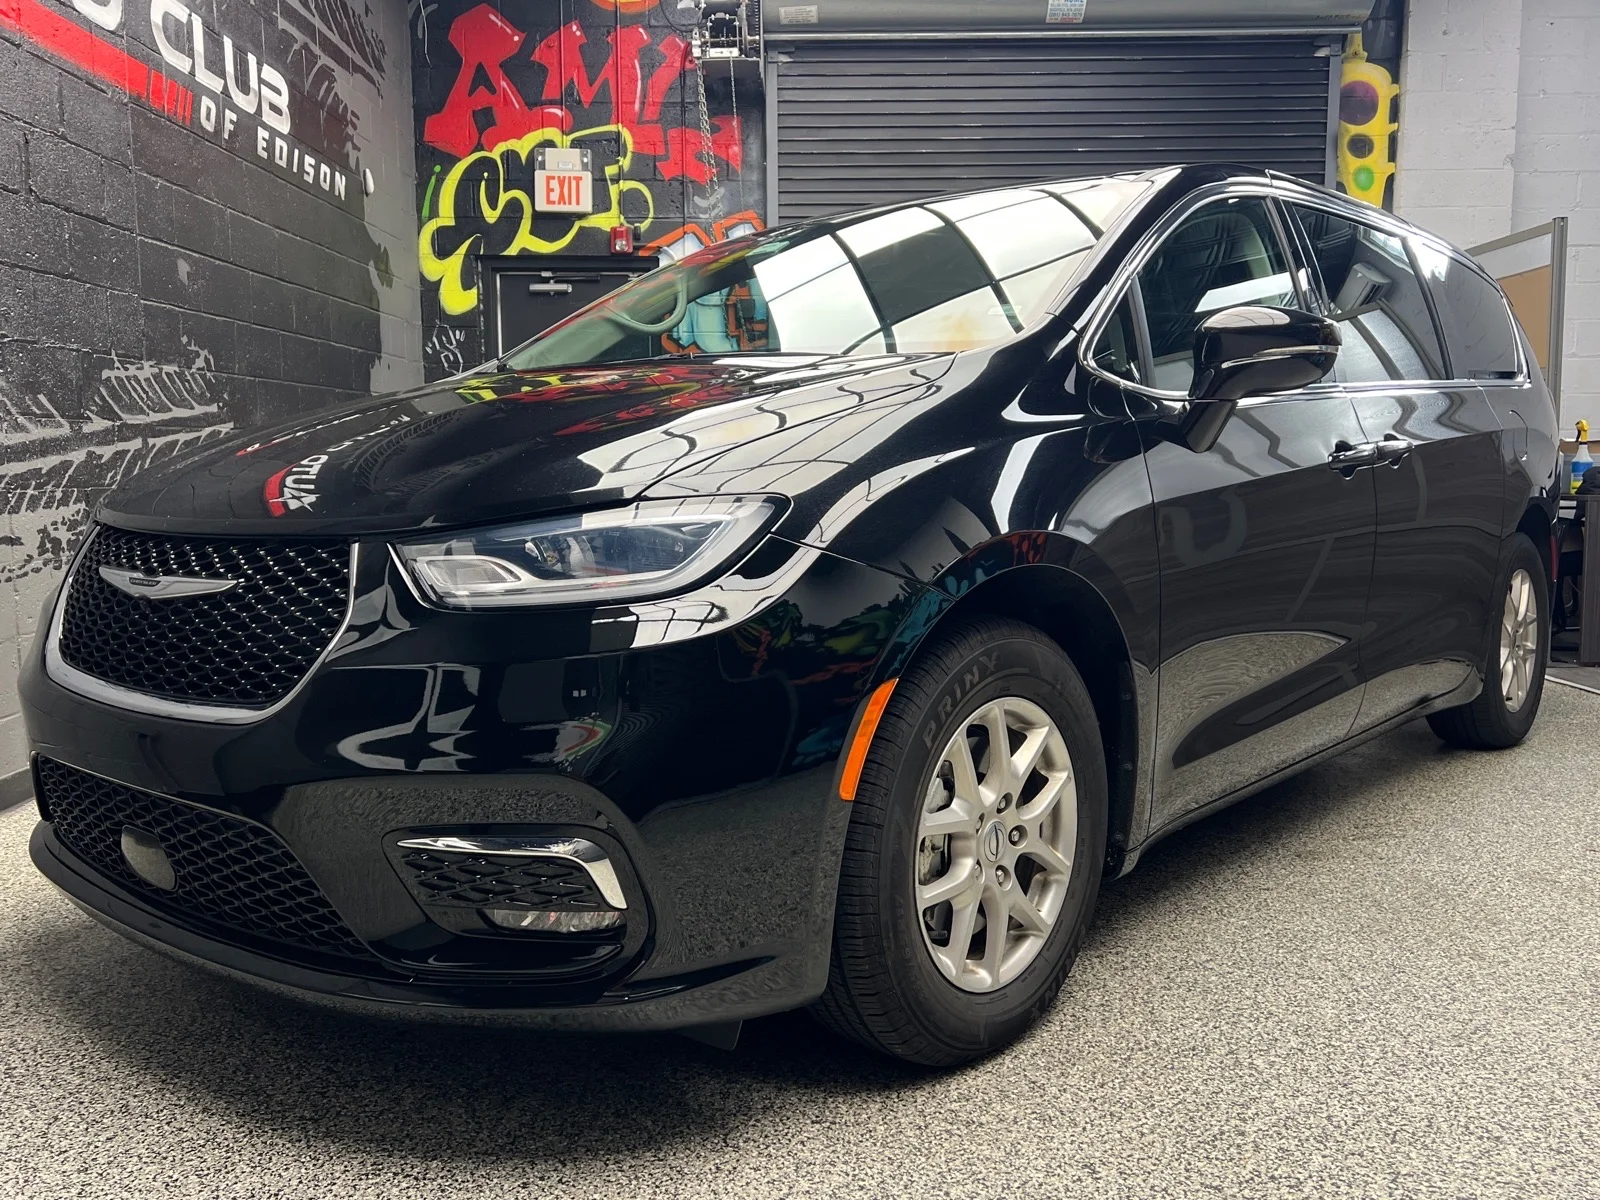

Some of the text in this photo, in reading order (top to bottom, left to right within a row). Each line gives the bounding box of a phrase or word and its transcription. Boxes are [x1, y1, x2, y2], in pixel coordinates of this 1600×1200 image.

[150, 0, 290, 135] CLUB
[200, 95, 346, 200] OF EDISON
[545, 175, 583, 206] EXIT
